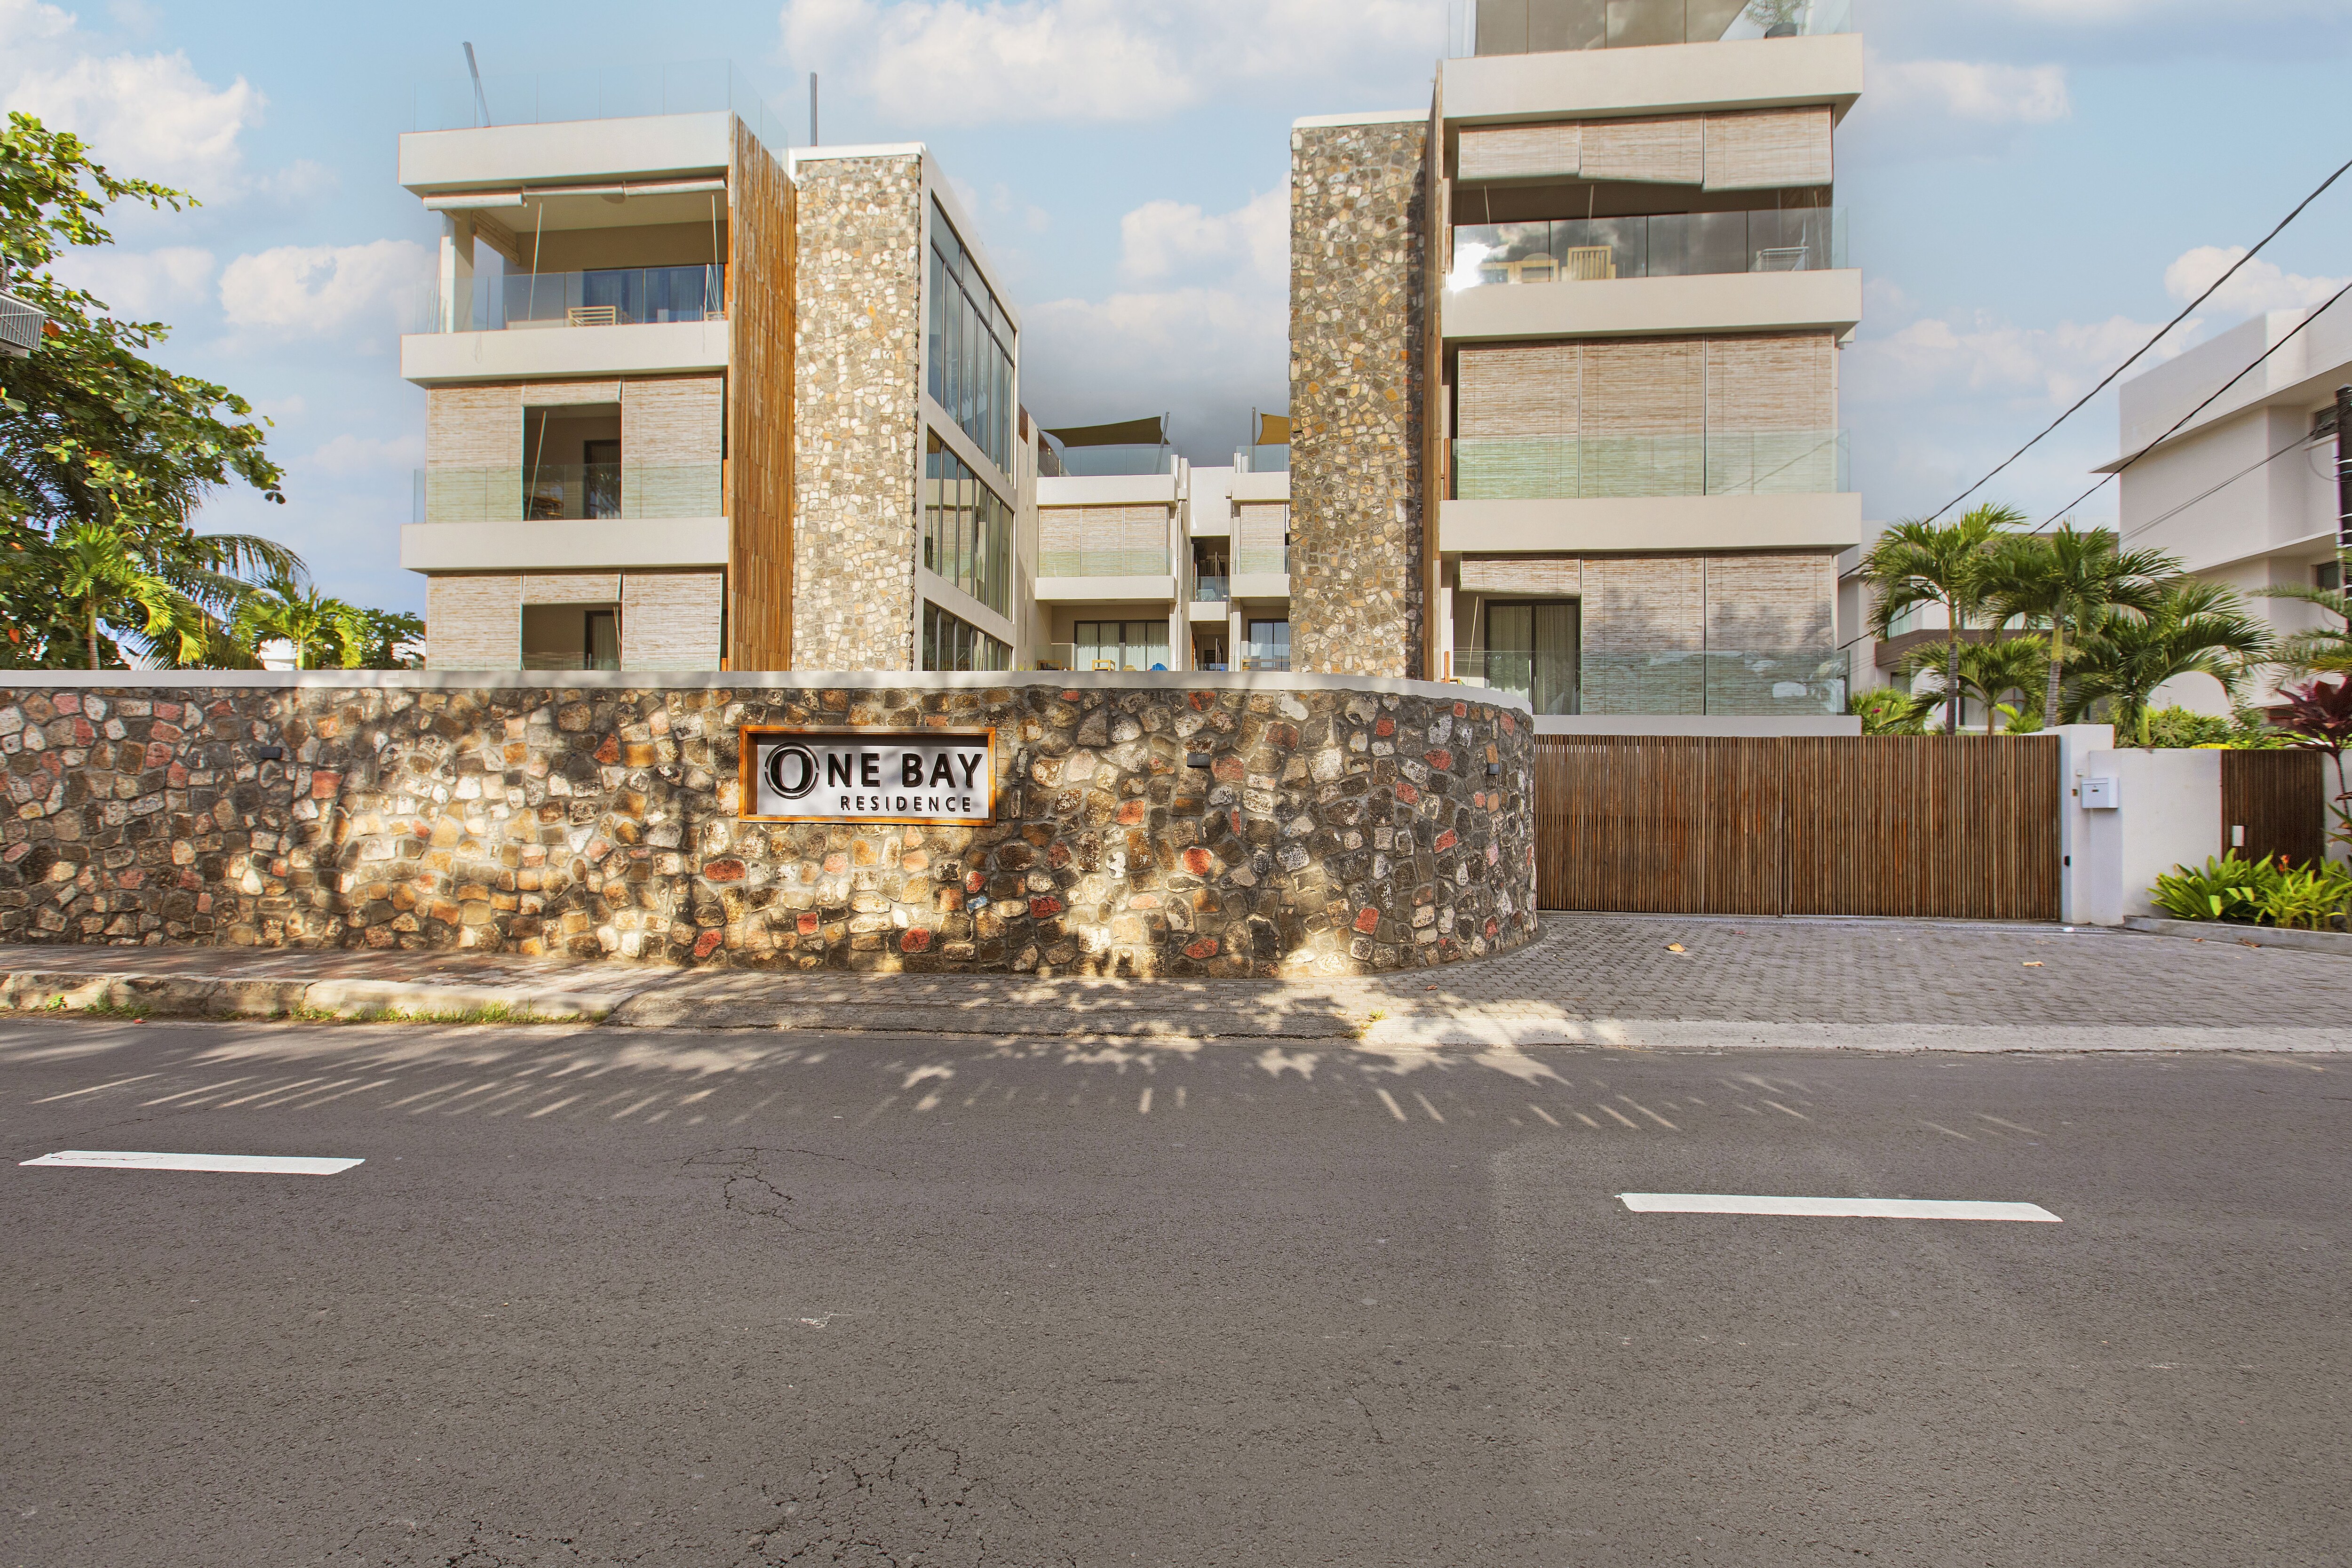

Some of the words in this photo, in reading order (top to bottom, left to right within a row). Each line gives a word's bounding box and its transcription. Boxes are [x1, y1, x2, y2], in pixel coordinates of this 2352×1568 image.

[770, 748, 881, 794] ONE
[902, 753, 983, 788] BAY
[840, 796, 971, 812] RESIDENCE
